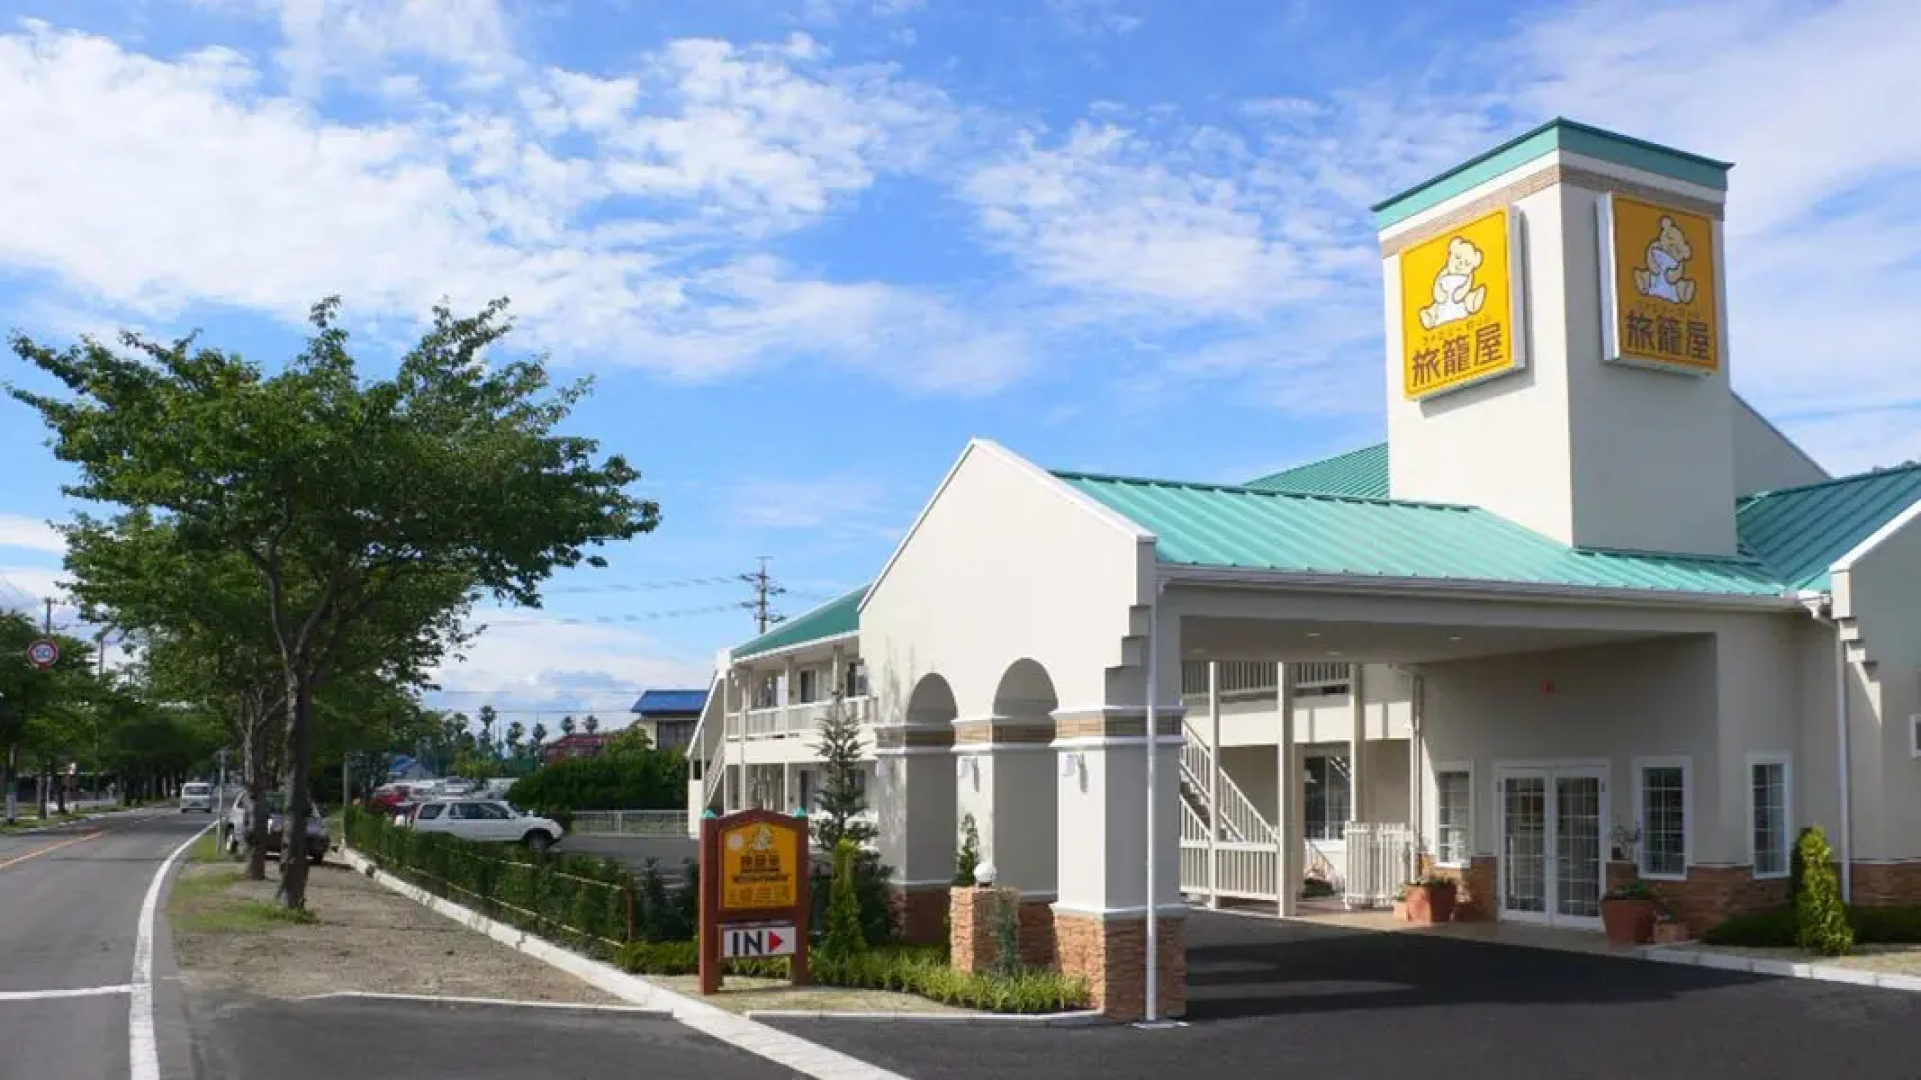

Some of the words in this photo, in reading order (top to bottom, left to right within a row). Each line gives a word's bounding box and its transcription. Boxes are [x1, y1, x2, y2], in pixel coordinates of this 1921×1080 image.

[1412, 321, 1503, 388] 旅籠屋
[732, 931, 763, 955] IN
